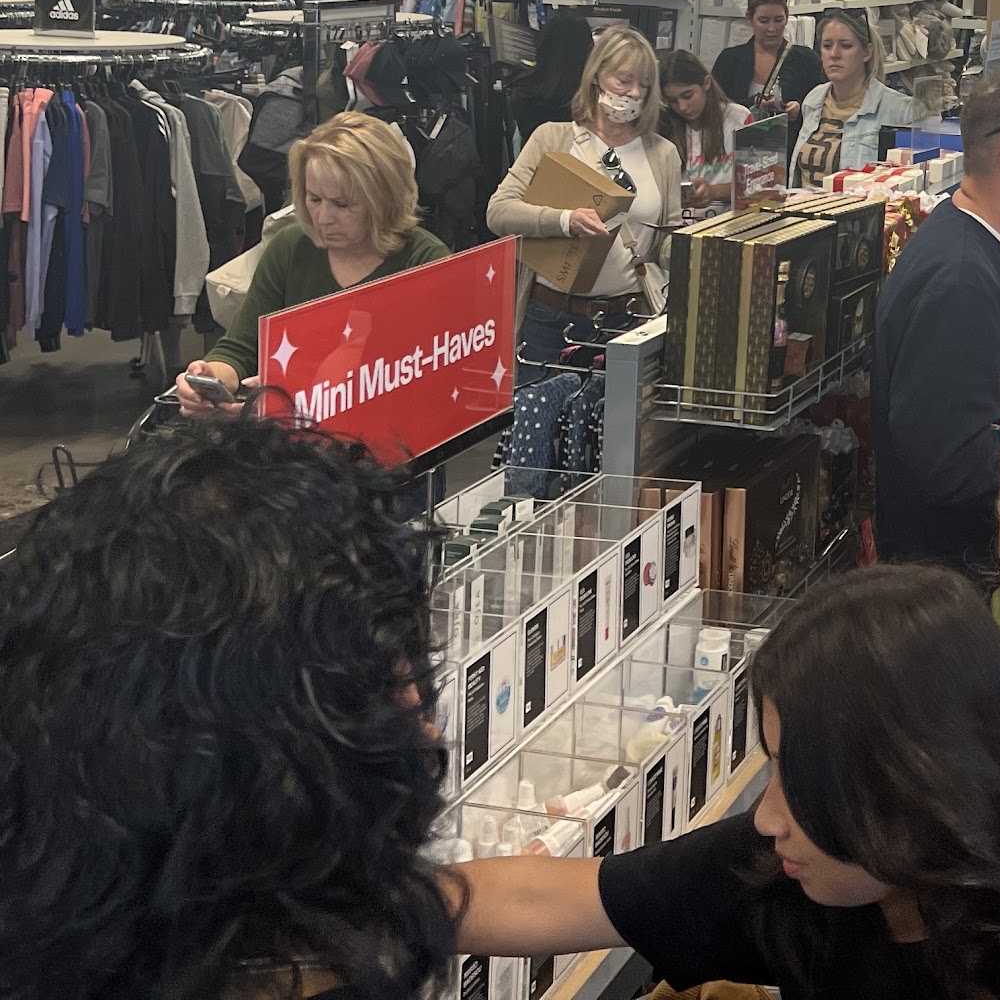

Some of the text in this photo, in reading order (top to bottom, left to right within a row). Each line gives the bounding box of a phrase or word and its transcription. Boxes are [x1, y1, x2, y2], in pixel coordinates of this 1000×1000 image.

[49, 9, 80, 21] adidas
[294, 318, 496, 429] Mini Must-Haves
